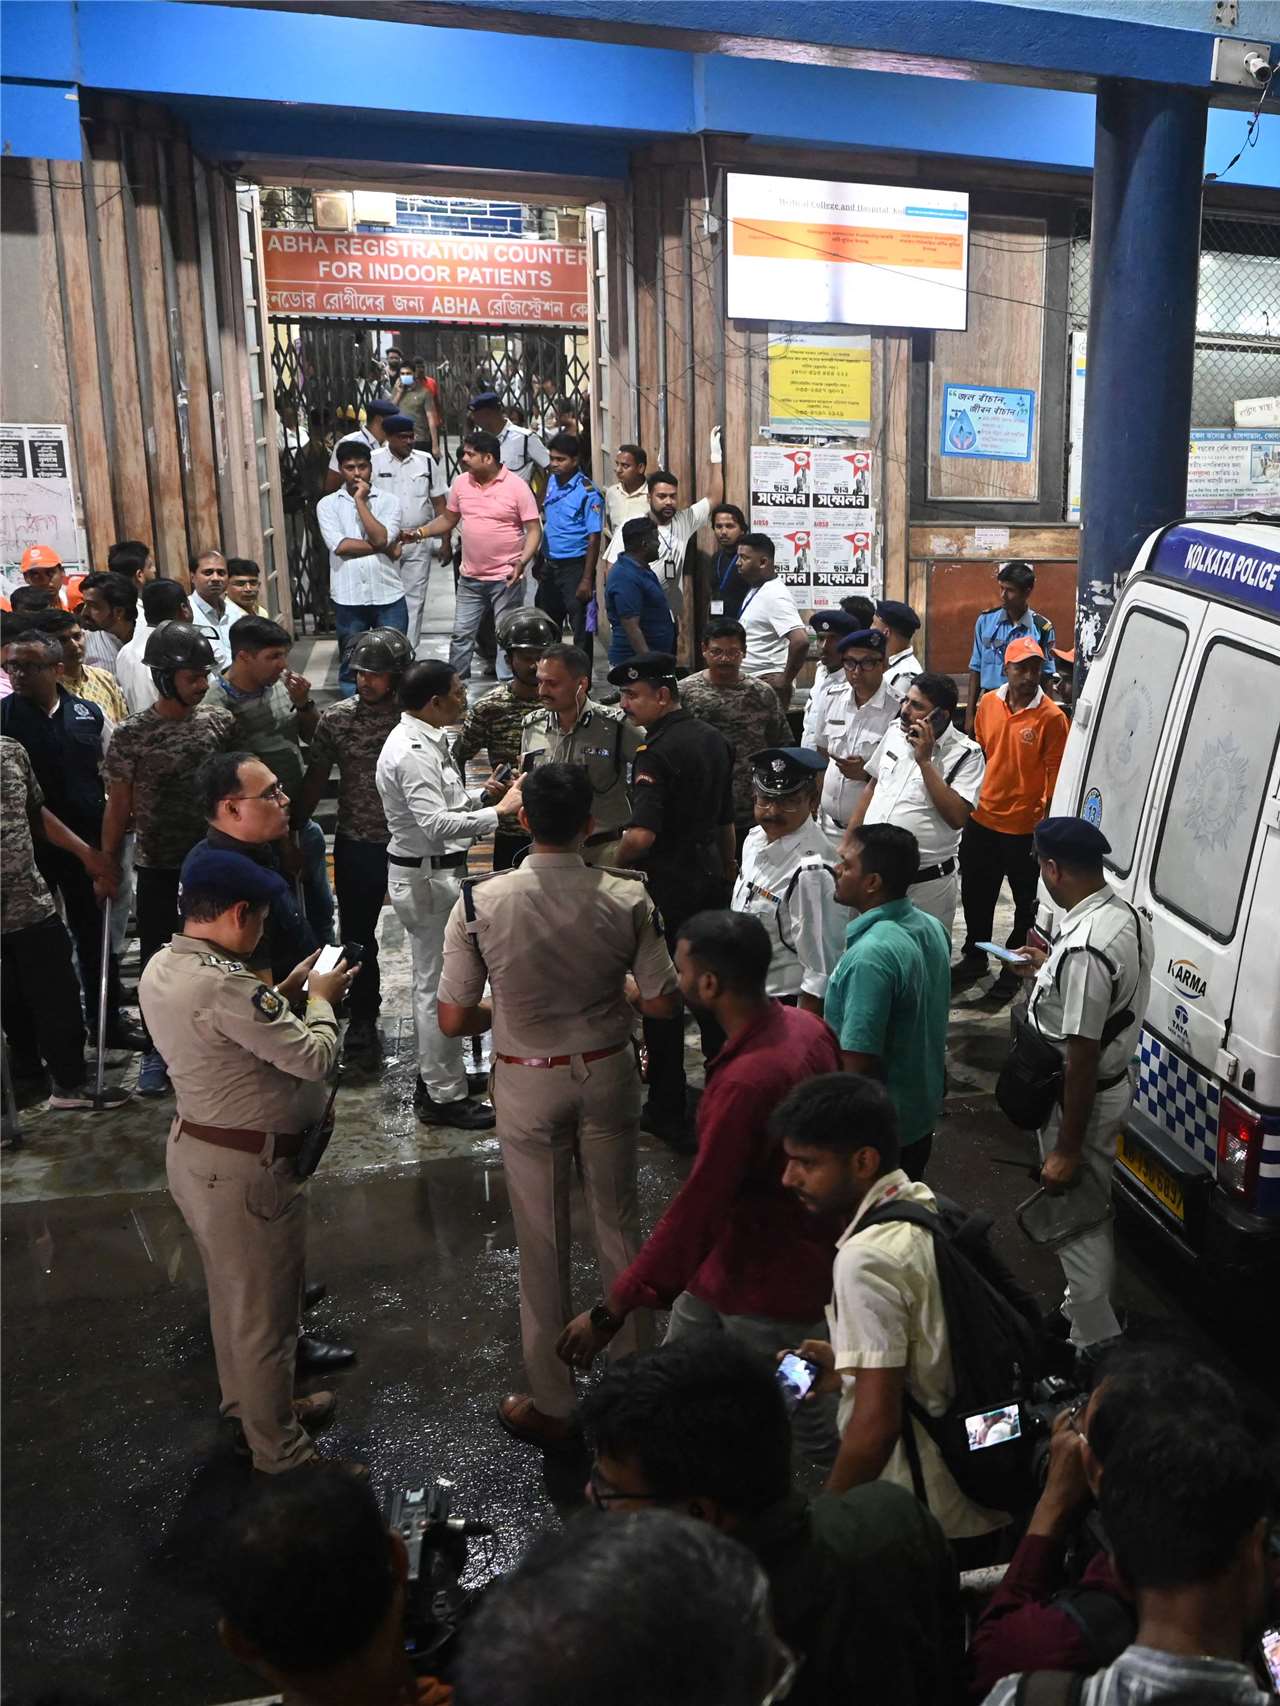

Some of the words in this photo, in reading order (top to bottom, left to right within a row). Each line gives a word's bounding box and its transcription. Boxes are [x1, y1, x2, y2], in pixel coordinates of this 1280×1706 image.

[811, 200, 839, 211] College
[840, 202, 855, 211] and
[267, 235, 328, 255] ABHA
[334, 238, 489, 263] REGISTRATION
[494, 246, 588, 266] COUNTER
[319, 261, 363, 279] FOR
[369, 264, 451, 283] INDOOR
[457, 267, 553, 287] PATIENTS
[323, 287, 385, 312] রোগীদের
[392, 295, 425, 313] জন্য
[431, 296, 481, 315] ABHA
[488, 293, 563, 320] রেজিস্ট্রেশন
[969, 403, 992, 415] জীবন
[757, 492, 806, 506] সম্মেলন
[817, 494, 865, 508] সম্মেলন
[1184, 543, 1236, 579] KOLKATA
[817, 573, 865, 586] সম্মেলন
[1167, 958, 1208, 997] KARMA
[1171, 1019, 1189, 1038] TATA
